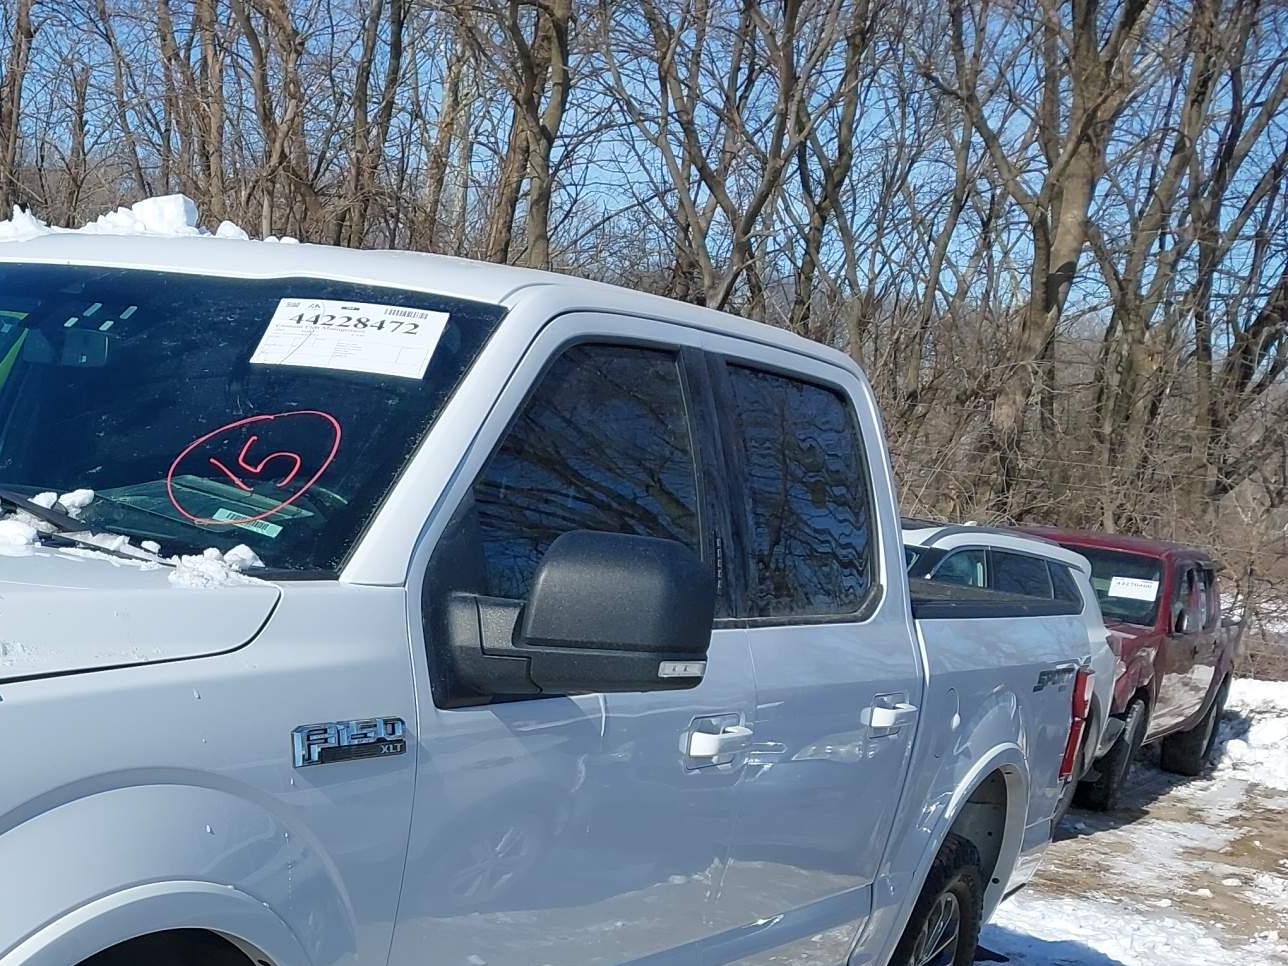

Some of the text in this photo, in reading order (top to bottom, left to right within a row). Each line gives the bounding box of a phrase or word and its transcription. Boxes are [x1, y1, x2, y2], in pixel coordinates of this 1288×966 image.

[289, 313, 419, 335] 44228472
[210, 435, 302, 492] 15
[380, 743, 401, 754] XLT
